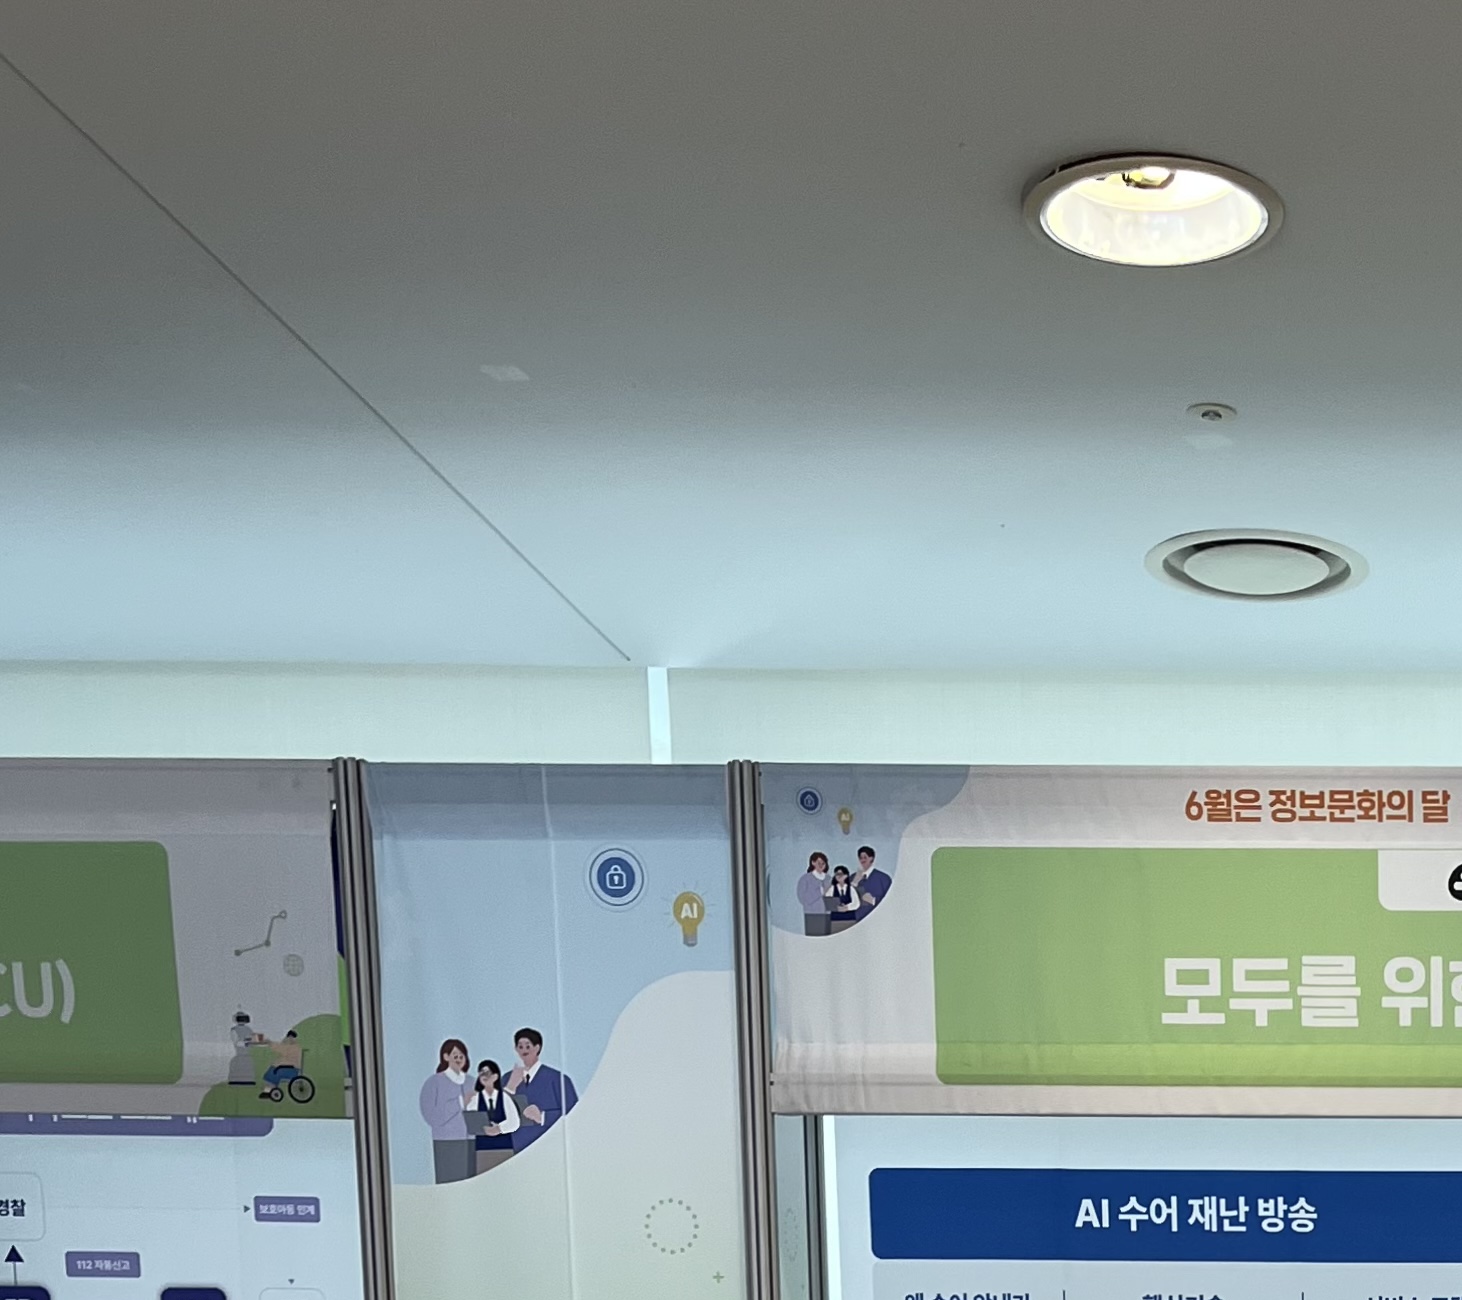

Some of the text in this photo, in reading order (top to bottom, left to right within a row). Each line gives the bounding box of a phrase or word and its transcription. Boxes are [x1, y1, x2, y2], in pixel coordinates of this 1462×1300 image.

[1185, 789, 1450, 823] 6월은 정보문화의 달
[1162, 955, 1361, 1027] 모두를
[1075, 1196, 1317, 1232] AI 수어 재난 방송
